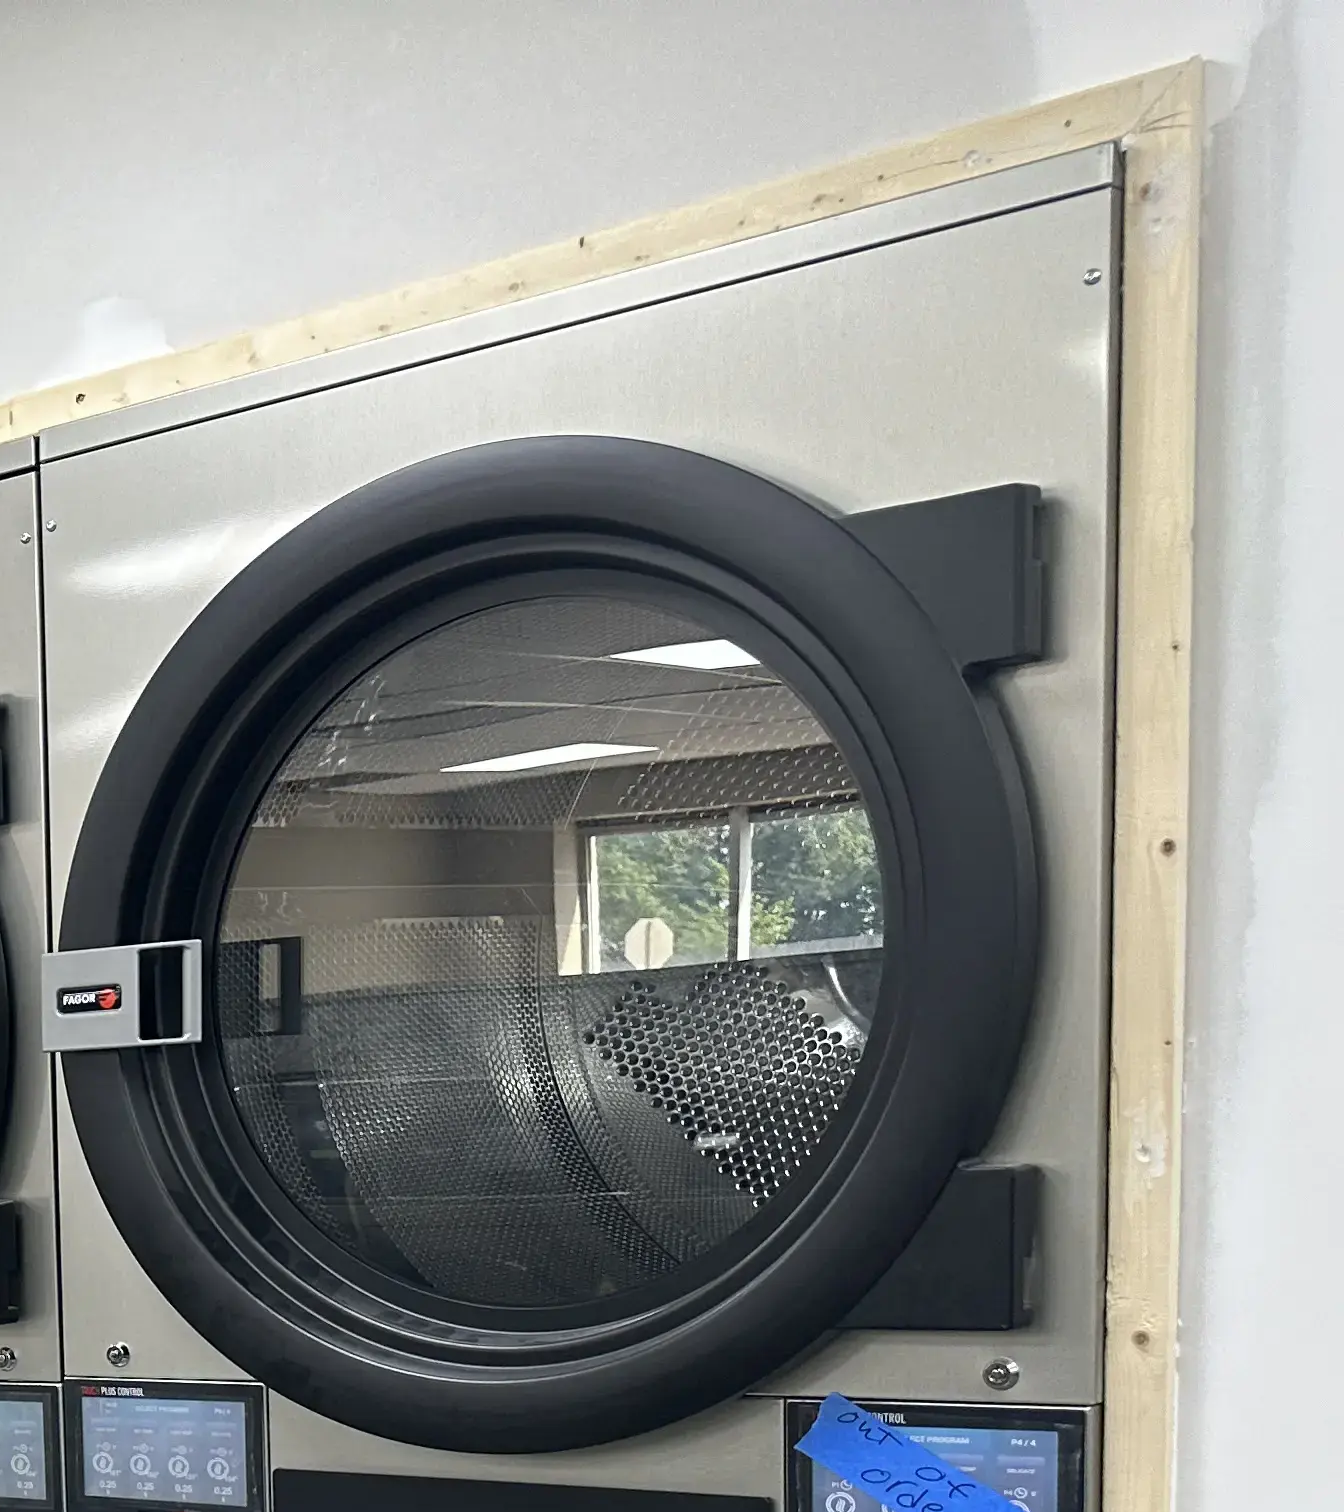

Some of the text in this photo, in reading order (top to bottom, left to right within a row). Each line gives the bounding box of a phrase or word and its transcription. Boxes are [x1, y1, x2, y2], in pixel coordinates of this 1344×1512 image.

[62, 992, 96, 1006] FAGOR
[100, 1386, 116, 1396] PLUS
[117, 1387, 144, 1397] CONTROL
[869, 1411, 907, 1425] ONTROL
[926, 1436, 970, 1444] PROGRAM
[99, 1480, 117, 1489] 0.25
[136, 1481, 155, 1490] 0.25
[174, 1483, 193, 1493] 0.25
[213, 1486, 233, 1495] 0.25
